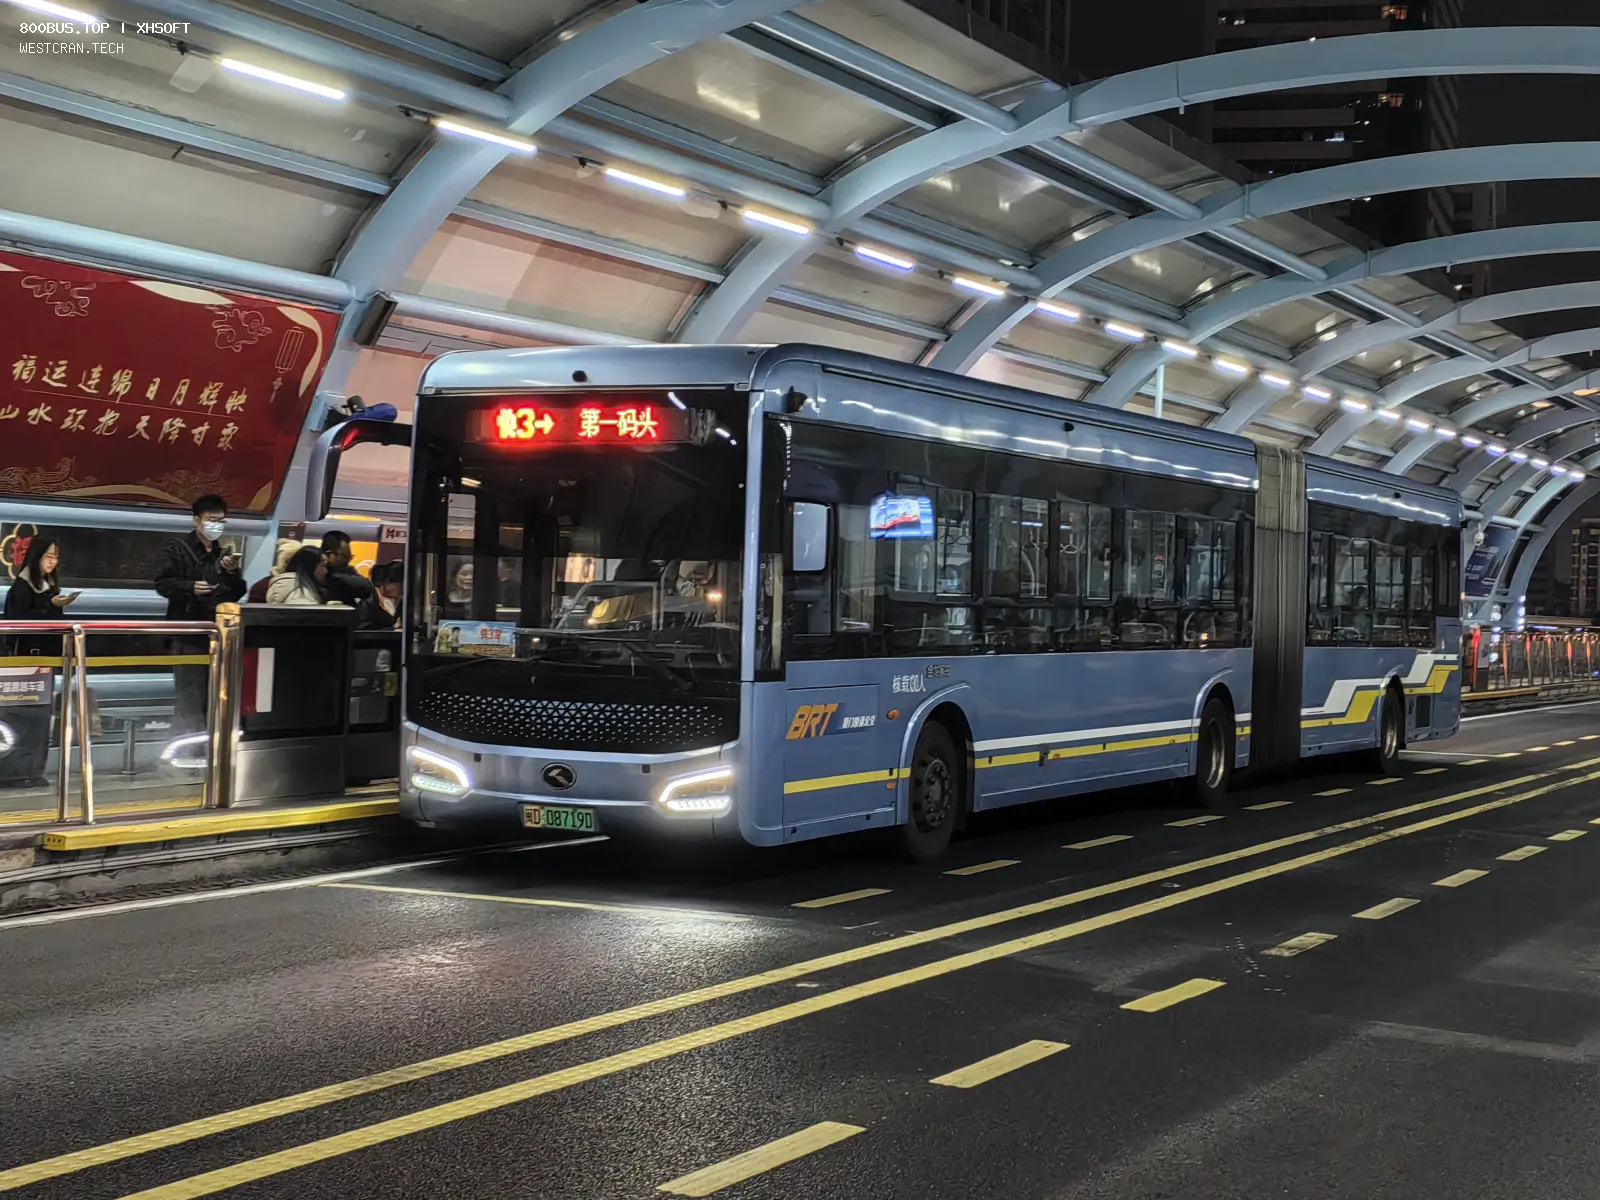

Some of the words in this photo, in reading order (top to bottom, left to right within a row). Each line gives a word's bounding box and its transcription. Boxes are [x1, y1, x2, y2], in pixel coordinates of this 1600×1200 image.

[578, 407, 658, 438] 第一码头
[785, 703, 839, 740] BRT
